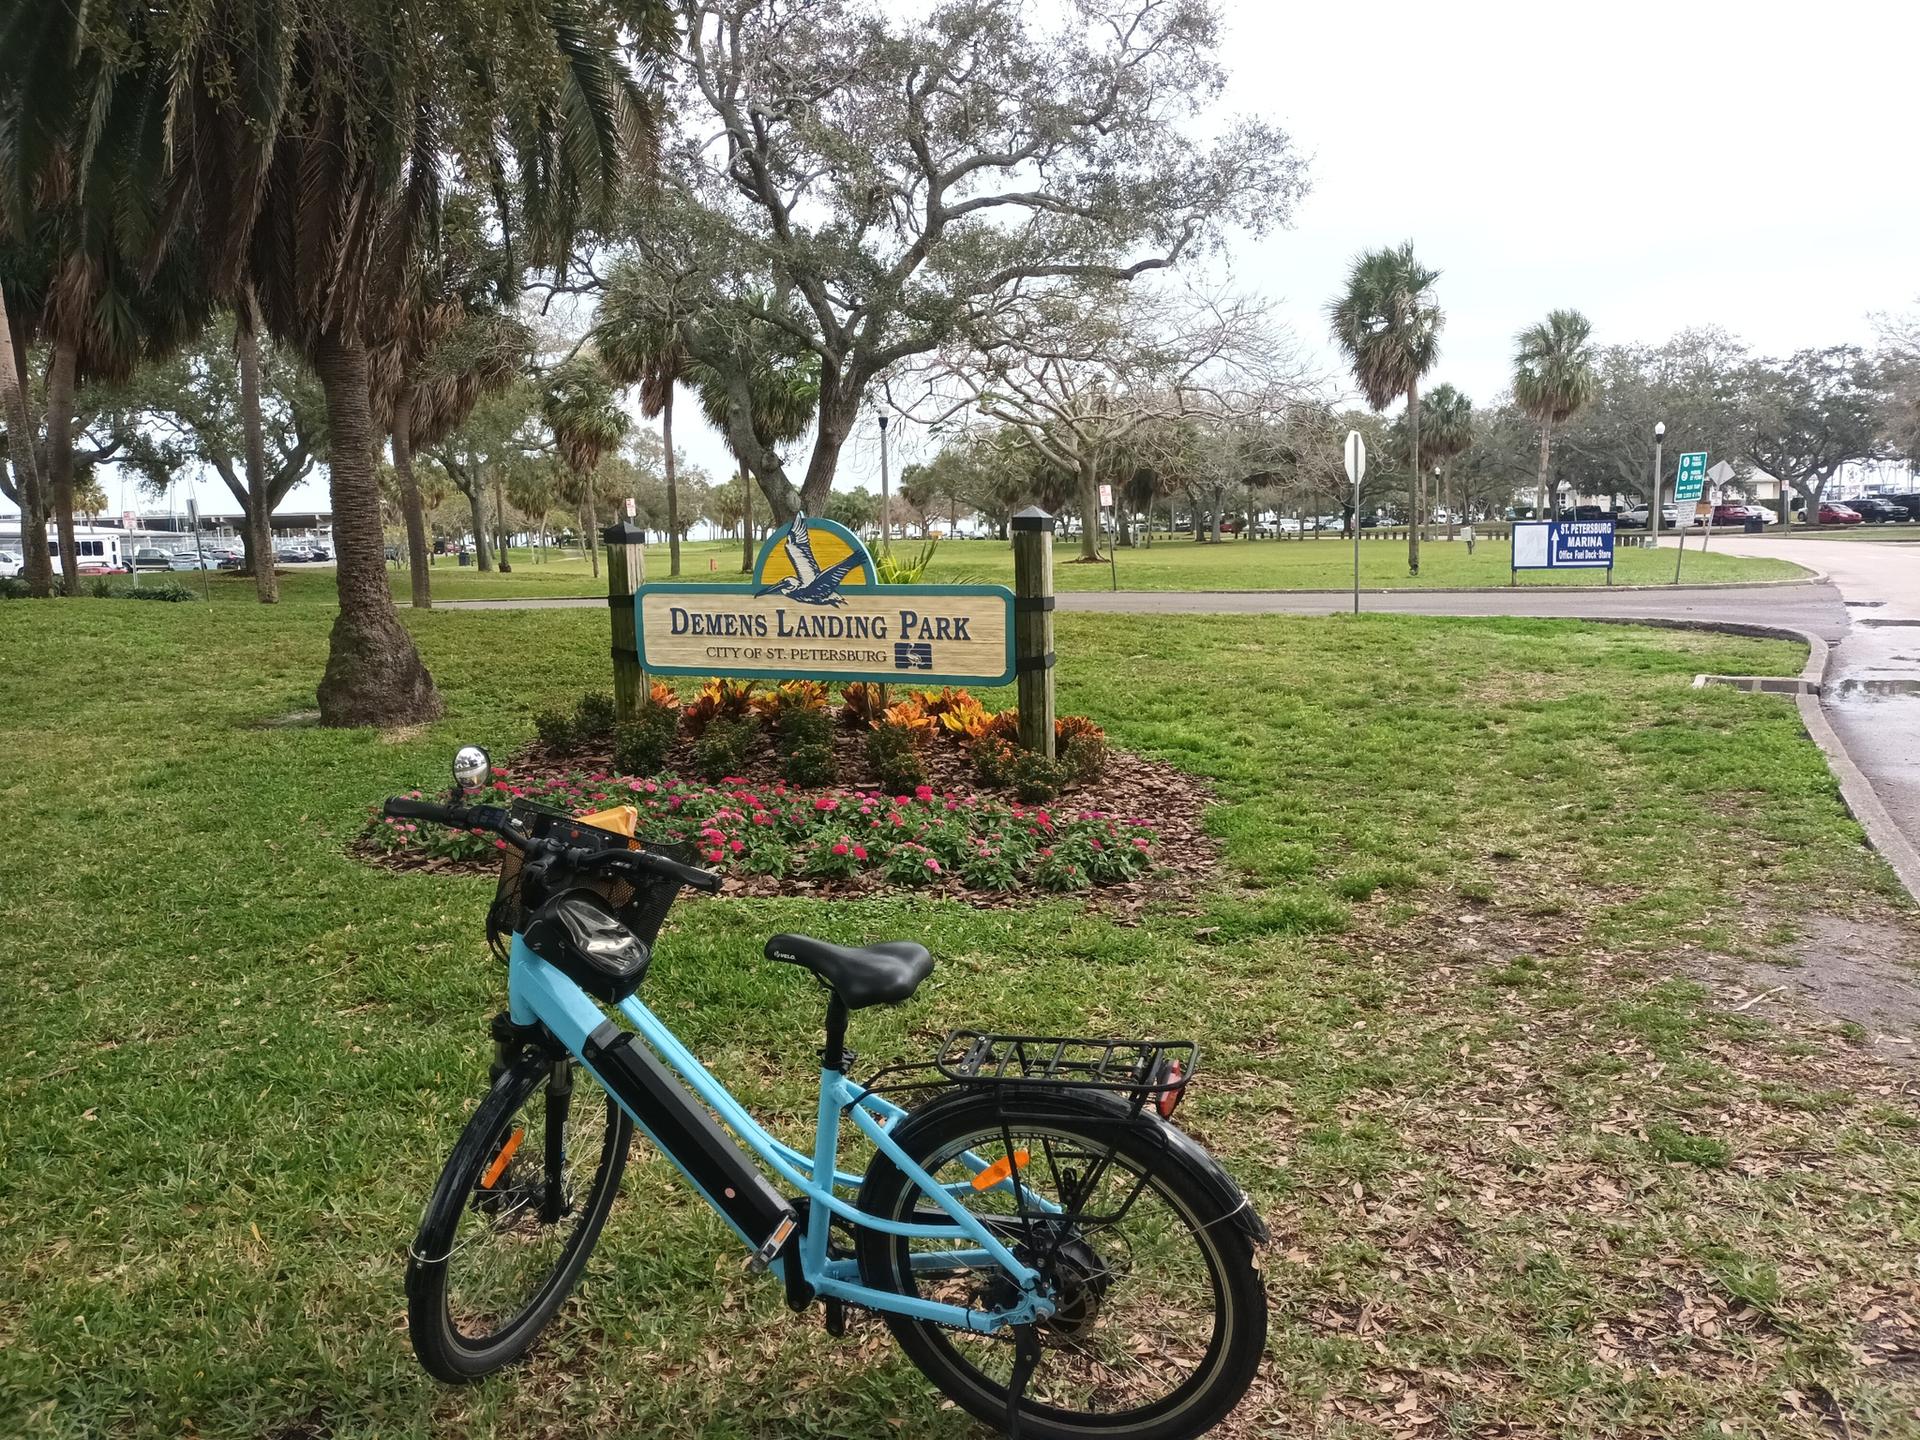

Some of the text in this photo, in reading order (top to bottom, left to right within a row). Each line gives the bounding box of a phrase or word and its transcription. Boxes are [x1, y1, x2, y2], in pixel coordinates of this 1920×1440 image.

[1570, 522, 1612, 534] PETERSBURG
[1567, 536, 1603, 548] MARINA
[1559, 549, 1573, 560] Office
[669, 607, 971, 641] DEMENS LANDING PARK
[706, 646, 887, 663] CITY OF ST. PETERSBURG
